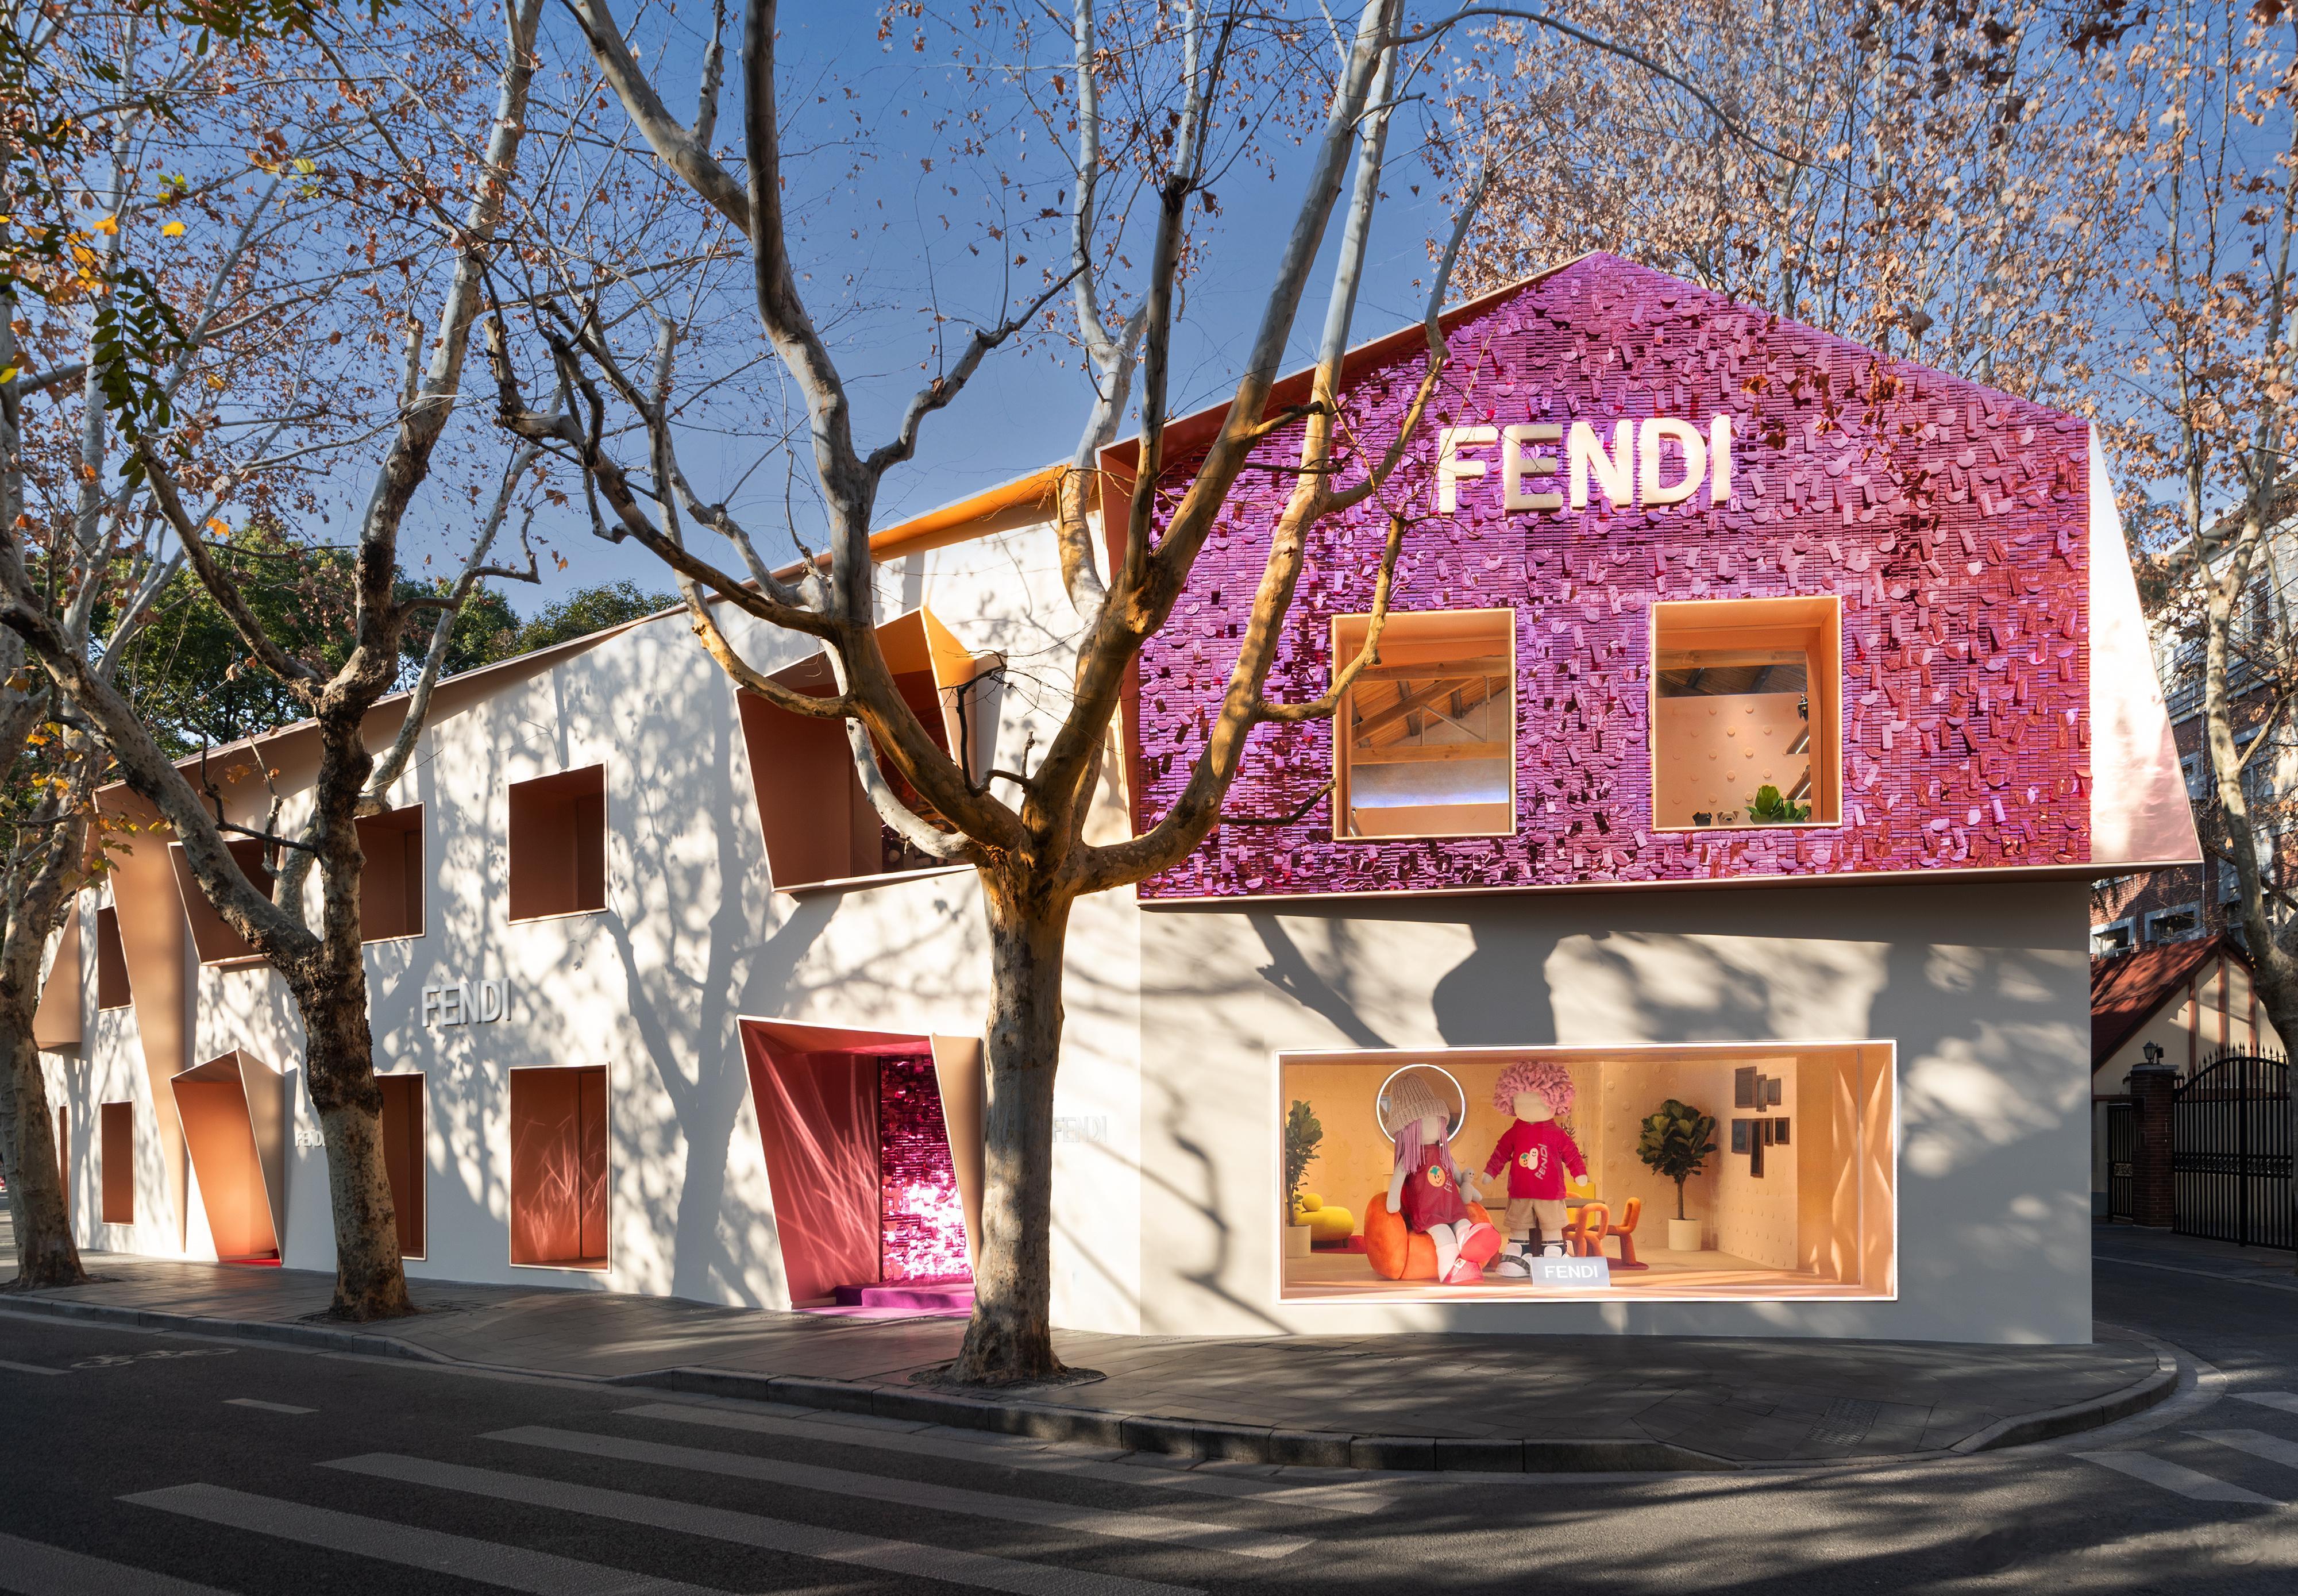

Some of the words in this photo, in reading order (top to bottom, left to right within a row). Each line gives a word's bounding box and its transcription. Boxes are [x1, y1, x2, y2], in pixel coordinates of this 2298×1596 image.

[1439, 414, 1731, 513] FENDI
[422, 978, 511, 1027] FENDI
[1052, 1116, 1107, 1143] FENDI
[1534, 1143, 1548, 1180] FENDI
[1544, 1265, 1598, 1278] FENDI
